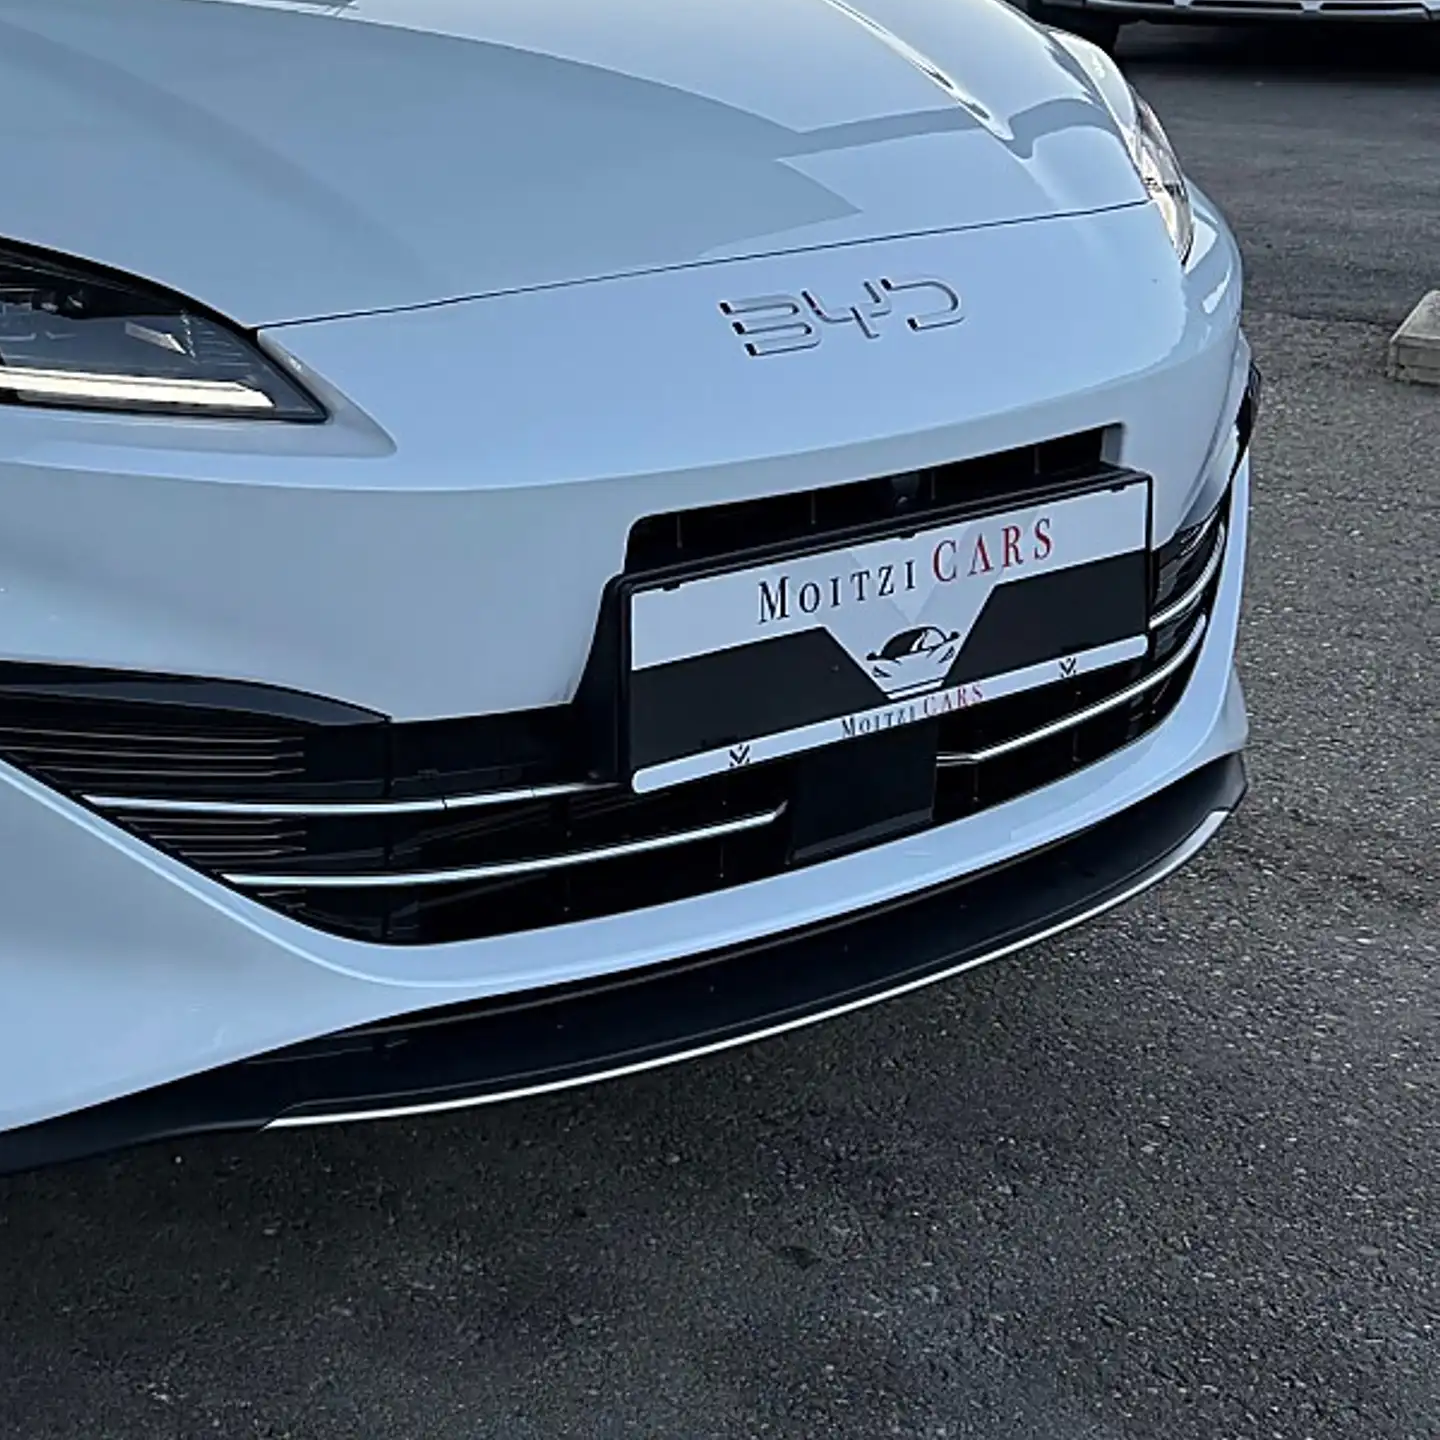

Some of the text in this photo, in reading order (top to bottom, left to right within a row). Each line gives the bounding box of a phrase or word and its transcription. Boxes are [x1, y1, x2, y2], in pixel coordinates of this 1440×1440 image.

[719, 277, 964, 357] BYD
[932, 517, 1053, 583] CARS
[923, 684, 984, 717] CARS
